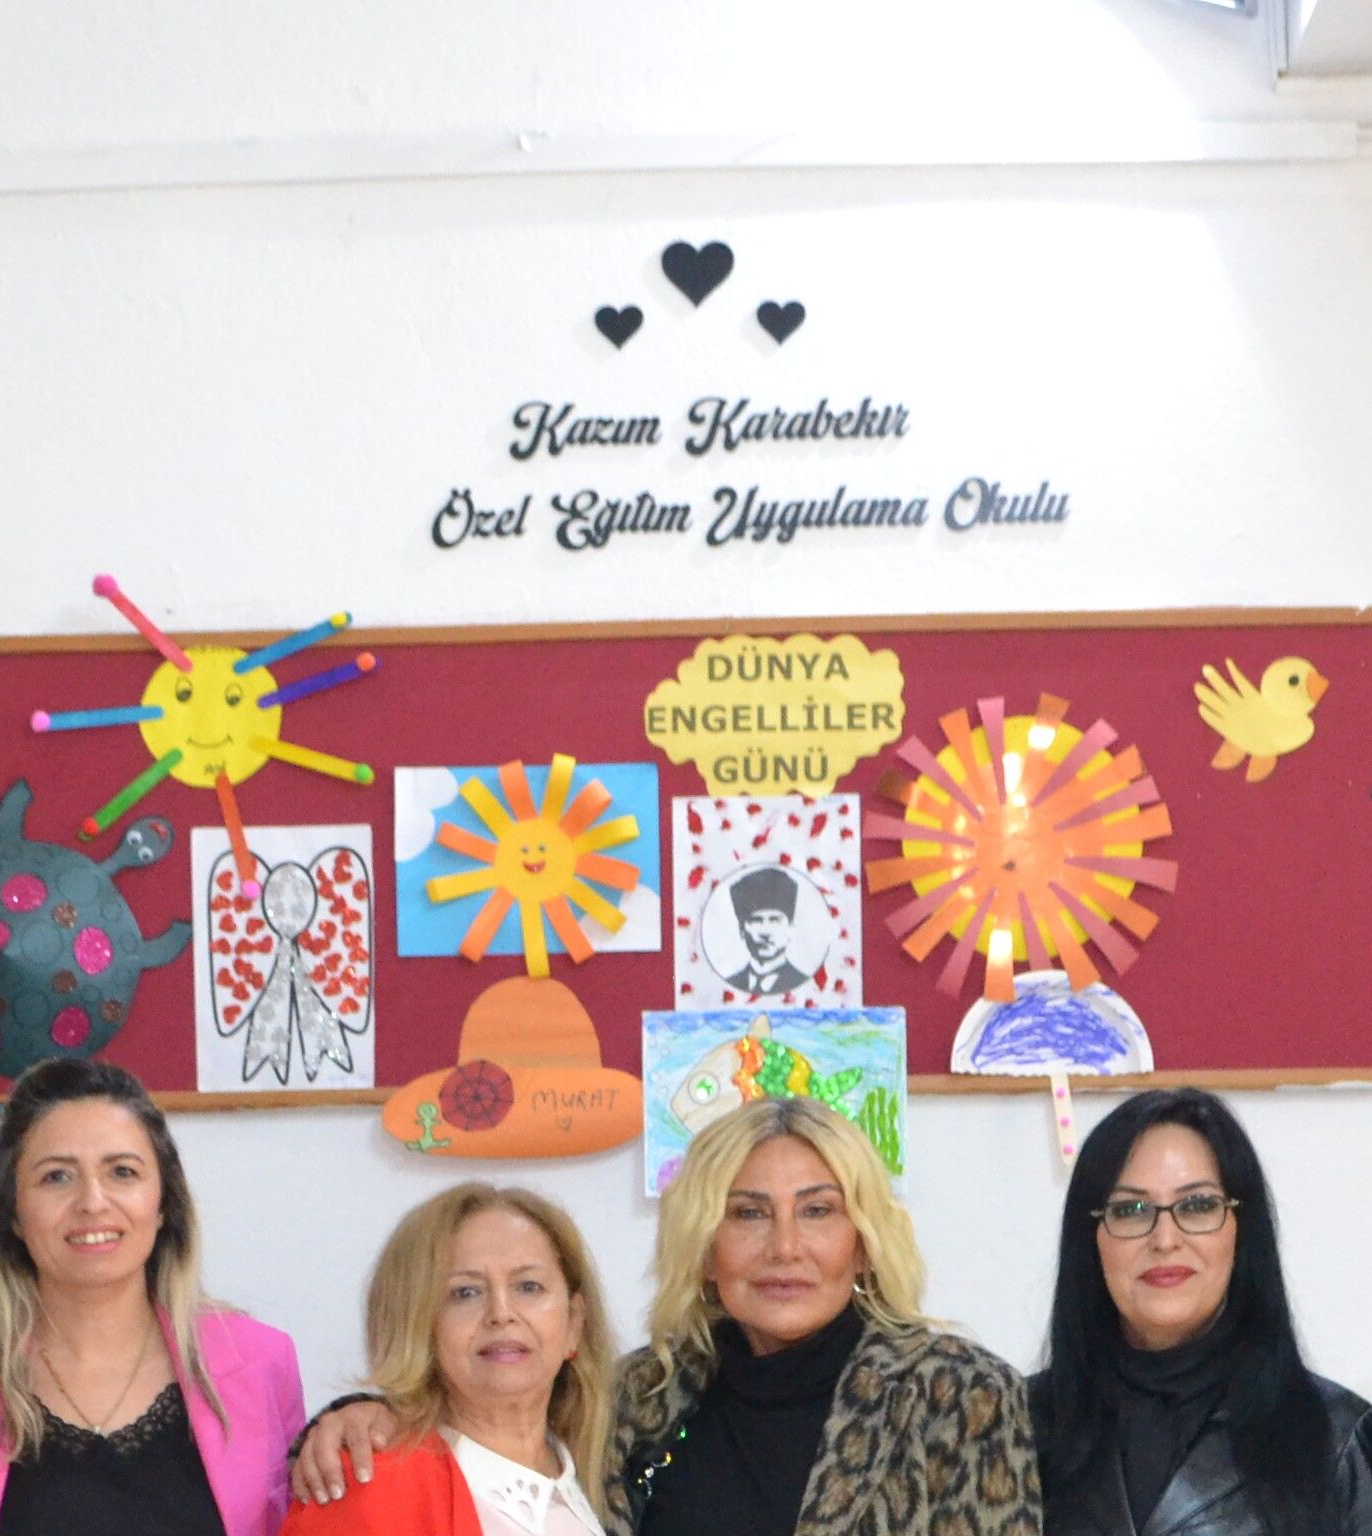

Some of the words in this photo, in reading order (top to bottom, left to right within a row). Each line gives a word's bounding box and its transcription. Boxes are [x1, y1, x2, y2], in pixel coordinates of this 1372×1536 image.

[509, 400, 662, 461] Kazım
[431, 487, 533, 549] Özel
[705, 484, 931, 547] Uygulama
[943, 476, 1071, 532] Okulu
[706, 645, 850, 682] DÜNYA
[647, 695, 897, 734] ENGELLİLER
[712, 747, 830, 784] GÜNÜ
[531, 1087, 620, 1112] MURAT
